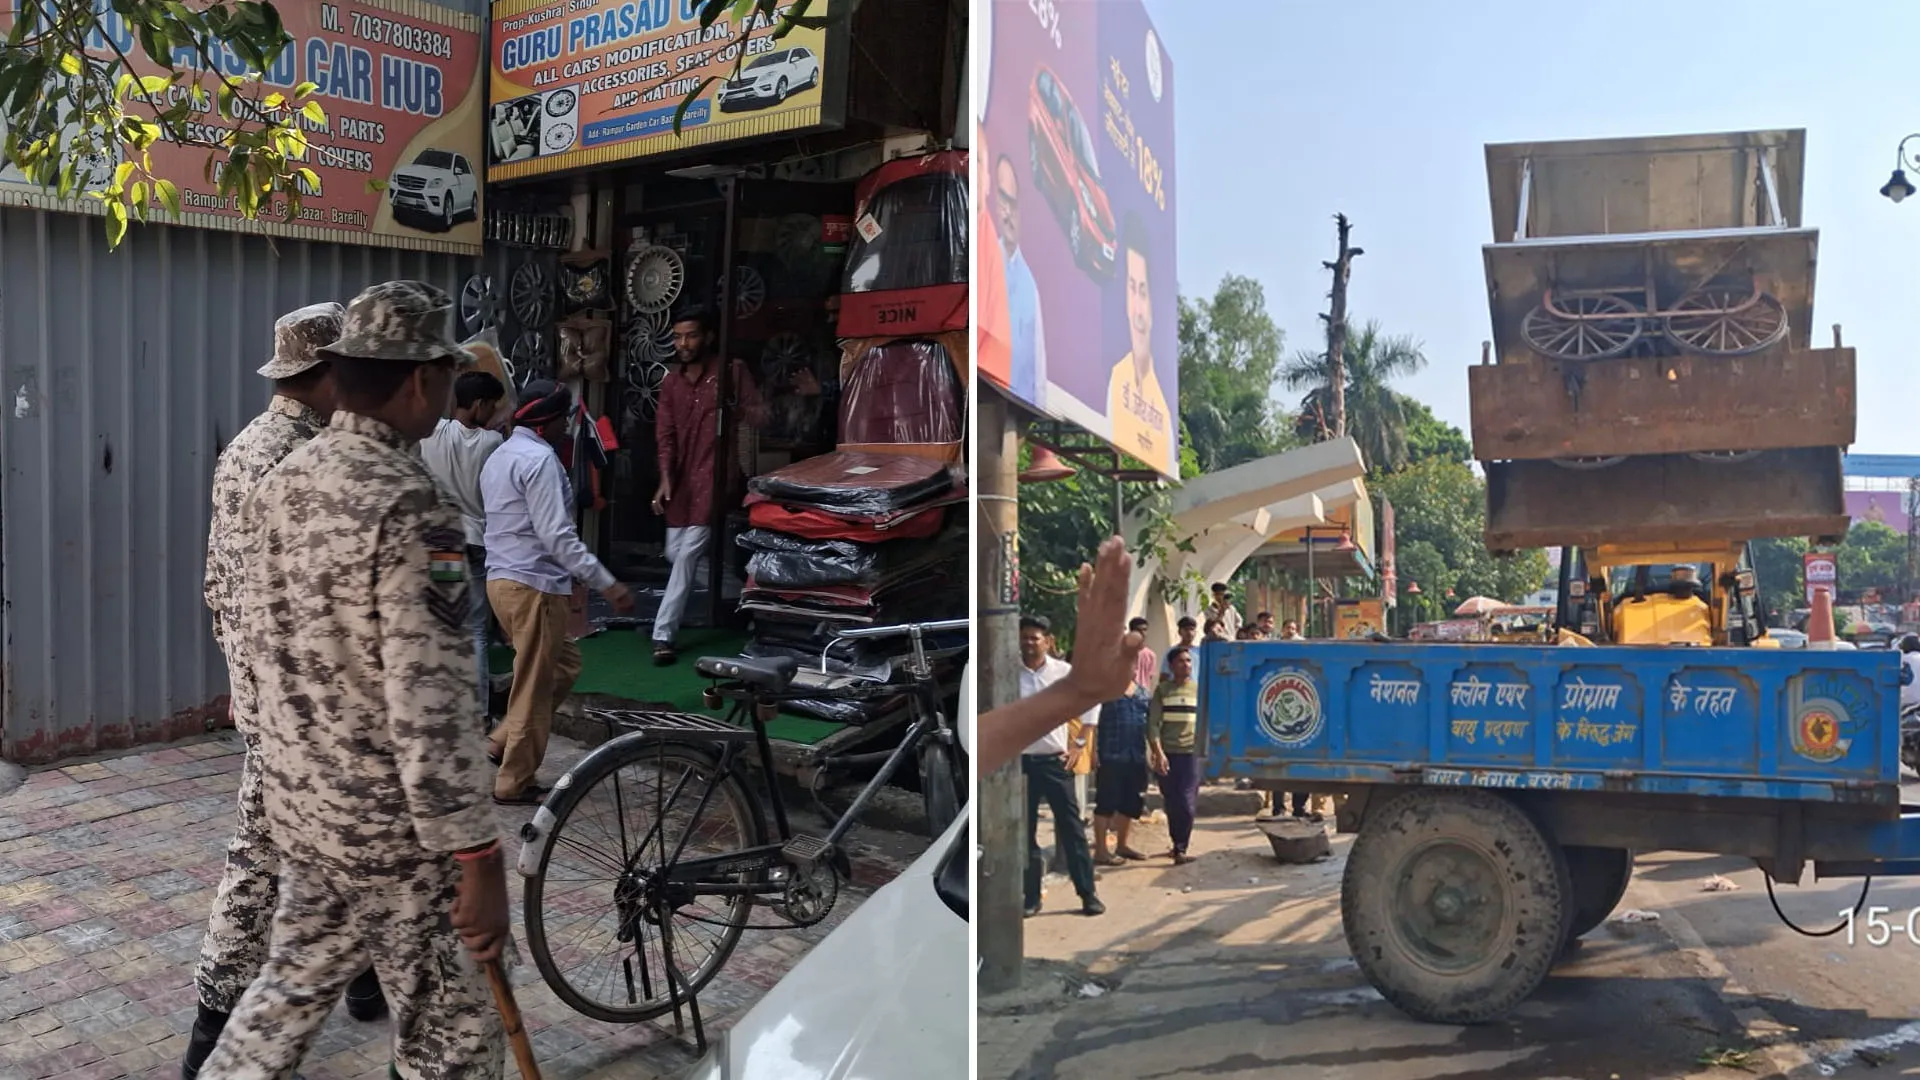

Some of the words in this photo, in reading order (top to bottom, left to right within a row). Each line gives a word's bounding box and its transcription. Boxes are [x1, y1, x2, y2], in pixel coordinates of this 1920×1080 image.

[320, 4, 344, 33] M.
[350, 11, 452, 59] 7037803384
[502, 24, 563, 74] GURU
[567, 0, 672, 55] PRASAD
[305, 36, 374, 106] CAR
[380, 53, 444, 119] HUB
[533, 69, 560, 87] ALL
[563, 56, 601, 79] CARS
[581, 61, 672, 95] ACCESSORIES,
[340, 116, 385, 145] PARTS
[317, 144, 373, 173] COVERS
[1136, 135, 1166, 212] 18%
[184, 188, 230, 212] Rampur
[330, 207, 368, 229] Bareilly
[878, 306, 917, 324] NICE
[1370, 672, 1421, 707] नेशनल
[1560, 676, 1622, 713] प्रोग्राम
[1670, 679, 1692, 711] के
[1694, 685, 1737, 718] तहत
